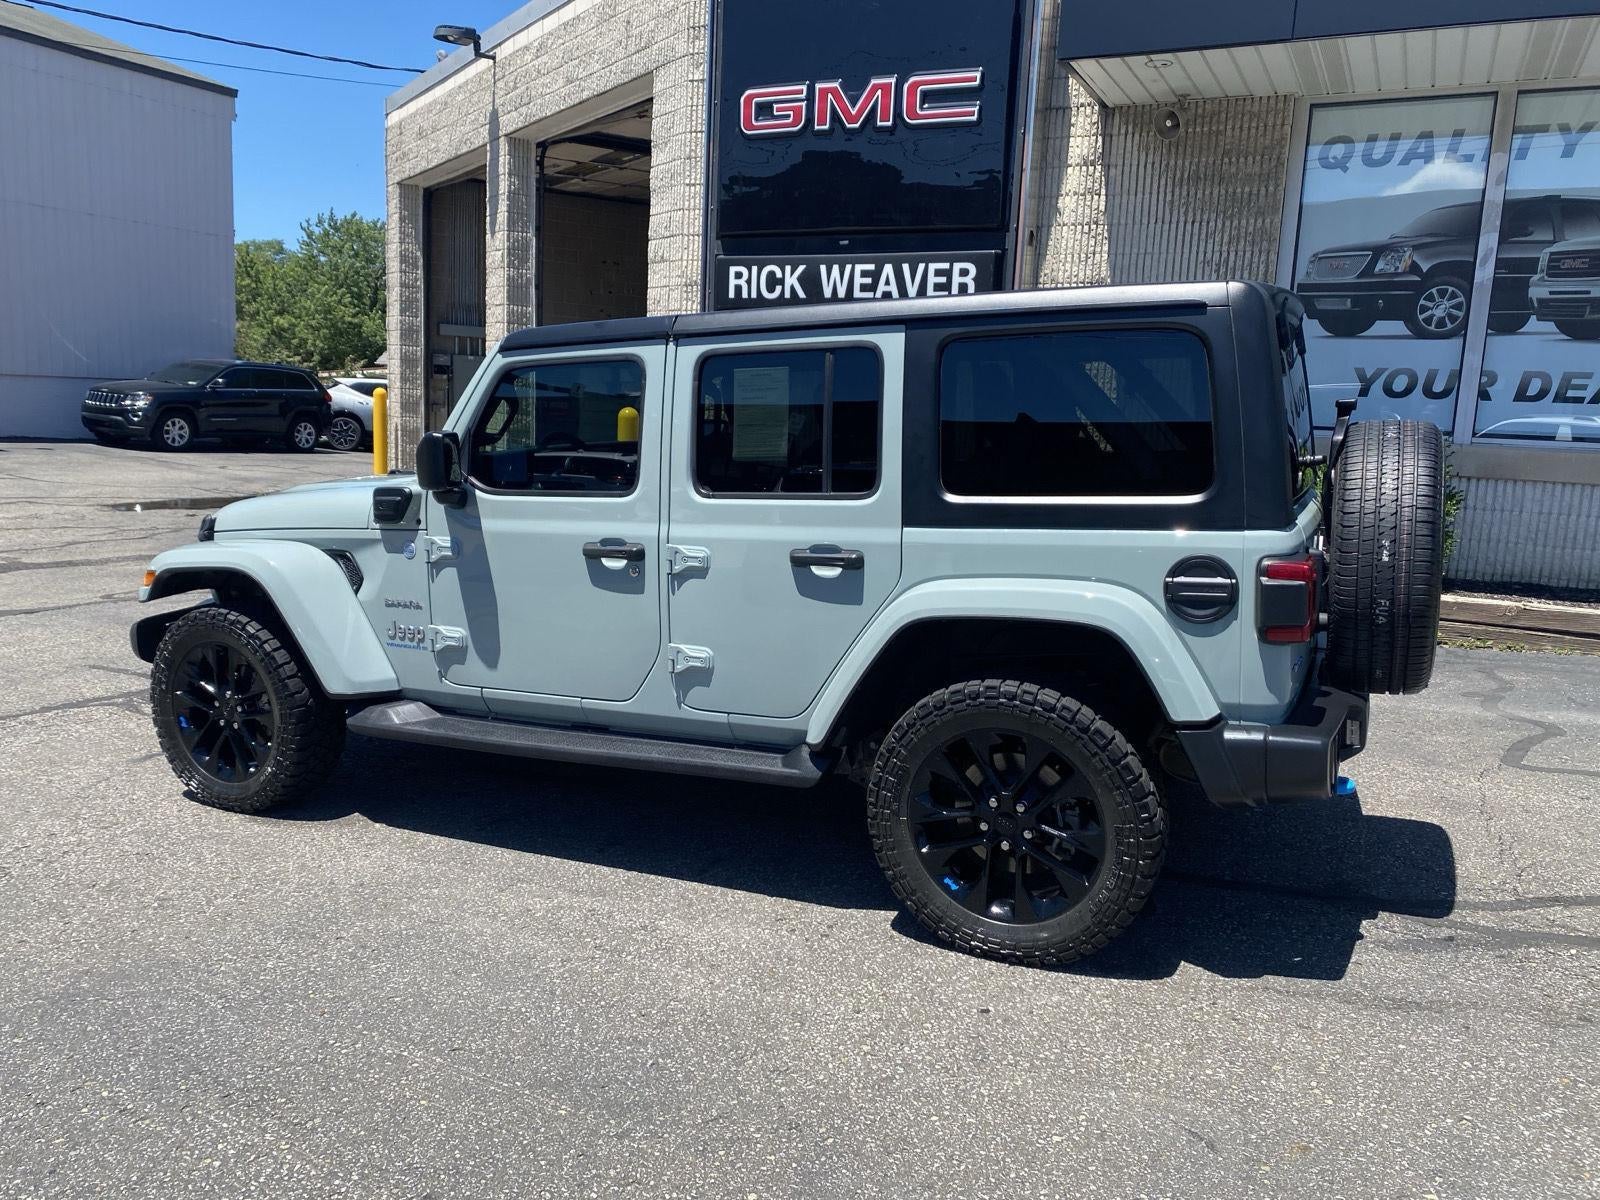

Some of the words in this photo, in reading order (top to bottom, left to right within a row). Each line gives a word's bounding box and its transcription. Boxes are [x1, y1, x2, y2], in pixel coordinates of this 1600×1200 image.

[740, 67, 983, 136] GMC
[728, 264, 807, 299] RICK
[820, 262, 977, 299] WEAVER
[387, 620, 426, 645] Jeep
